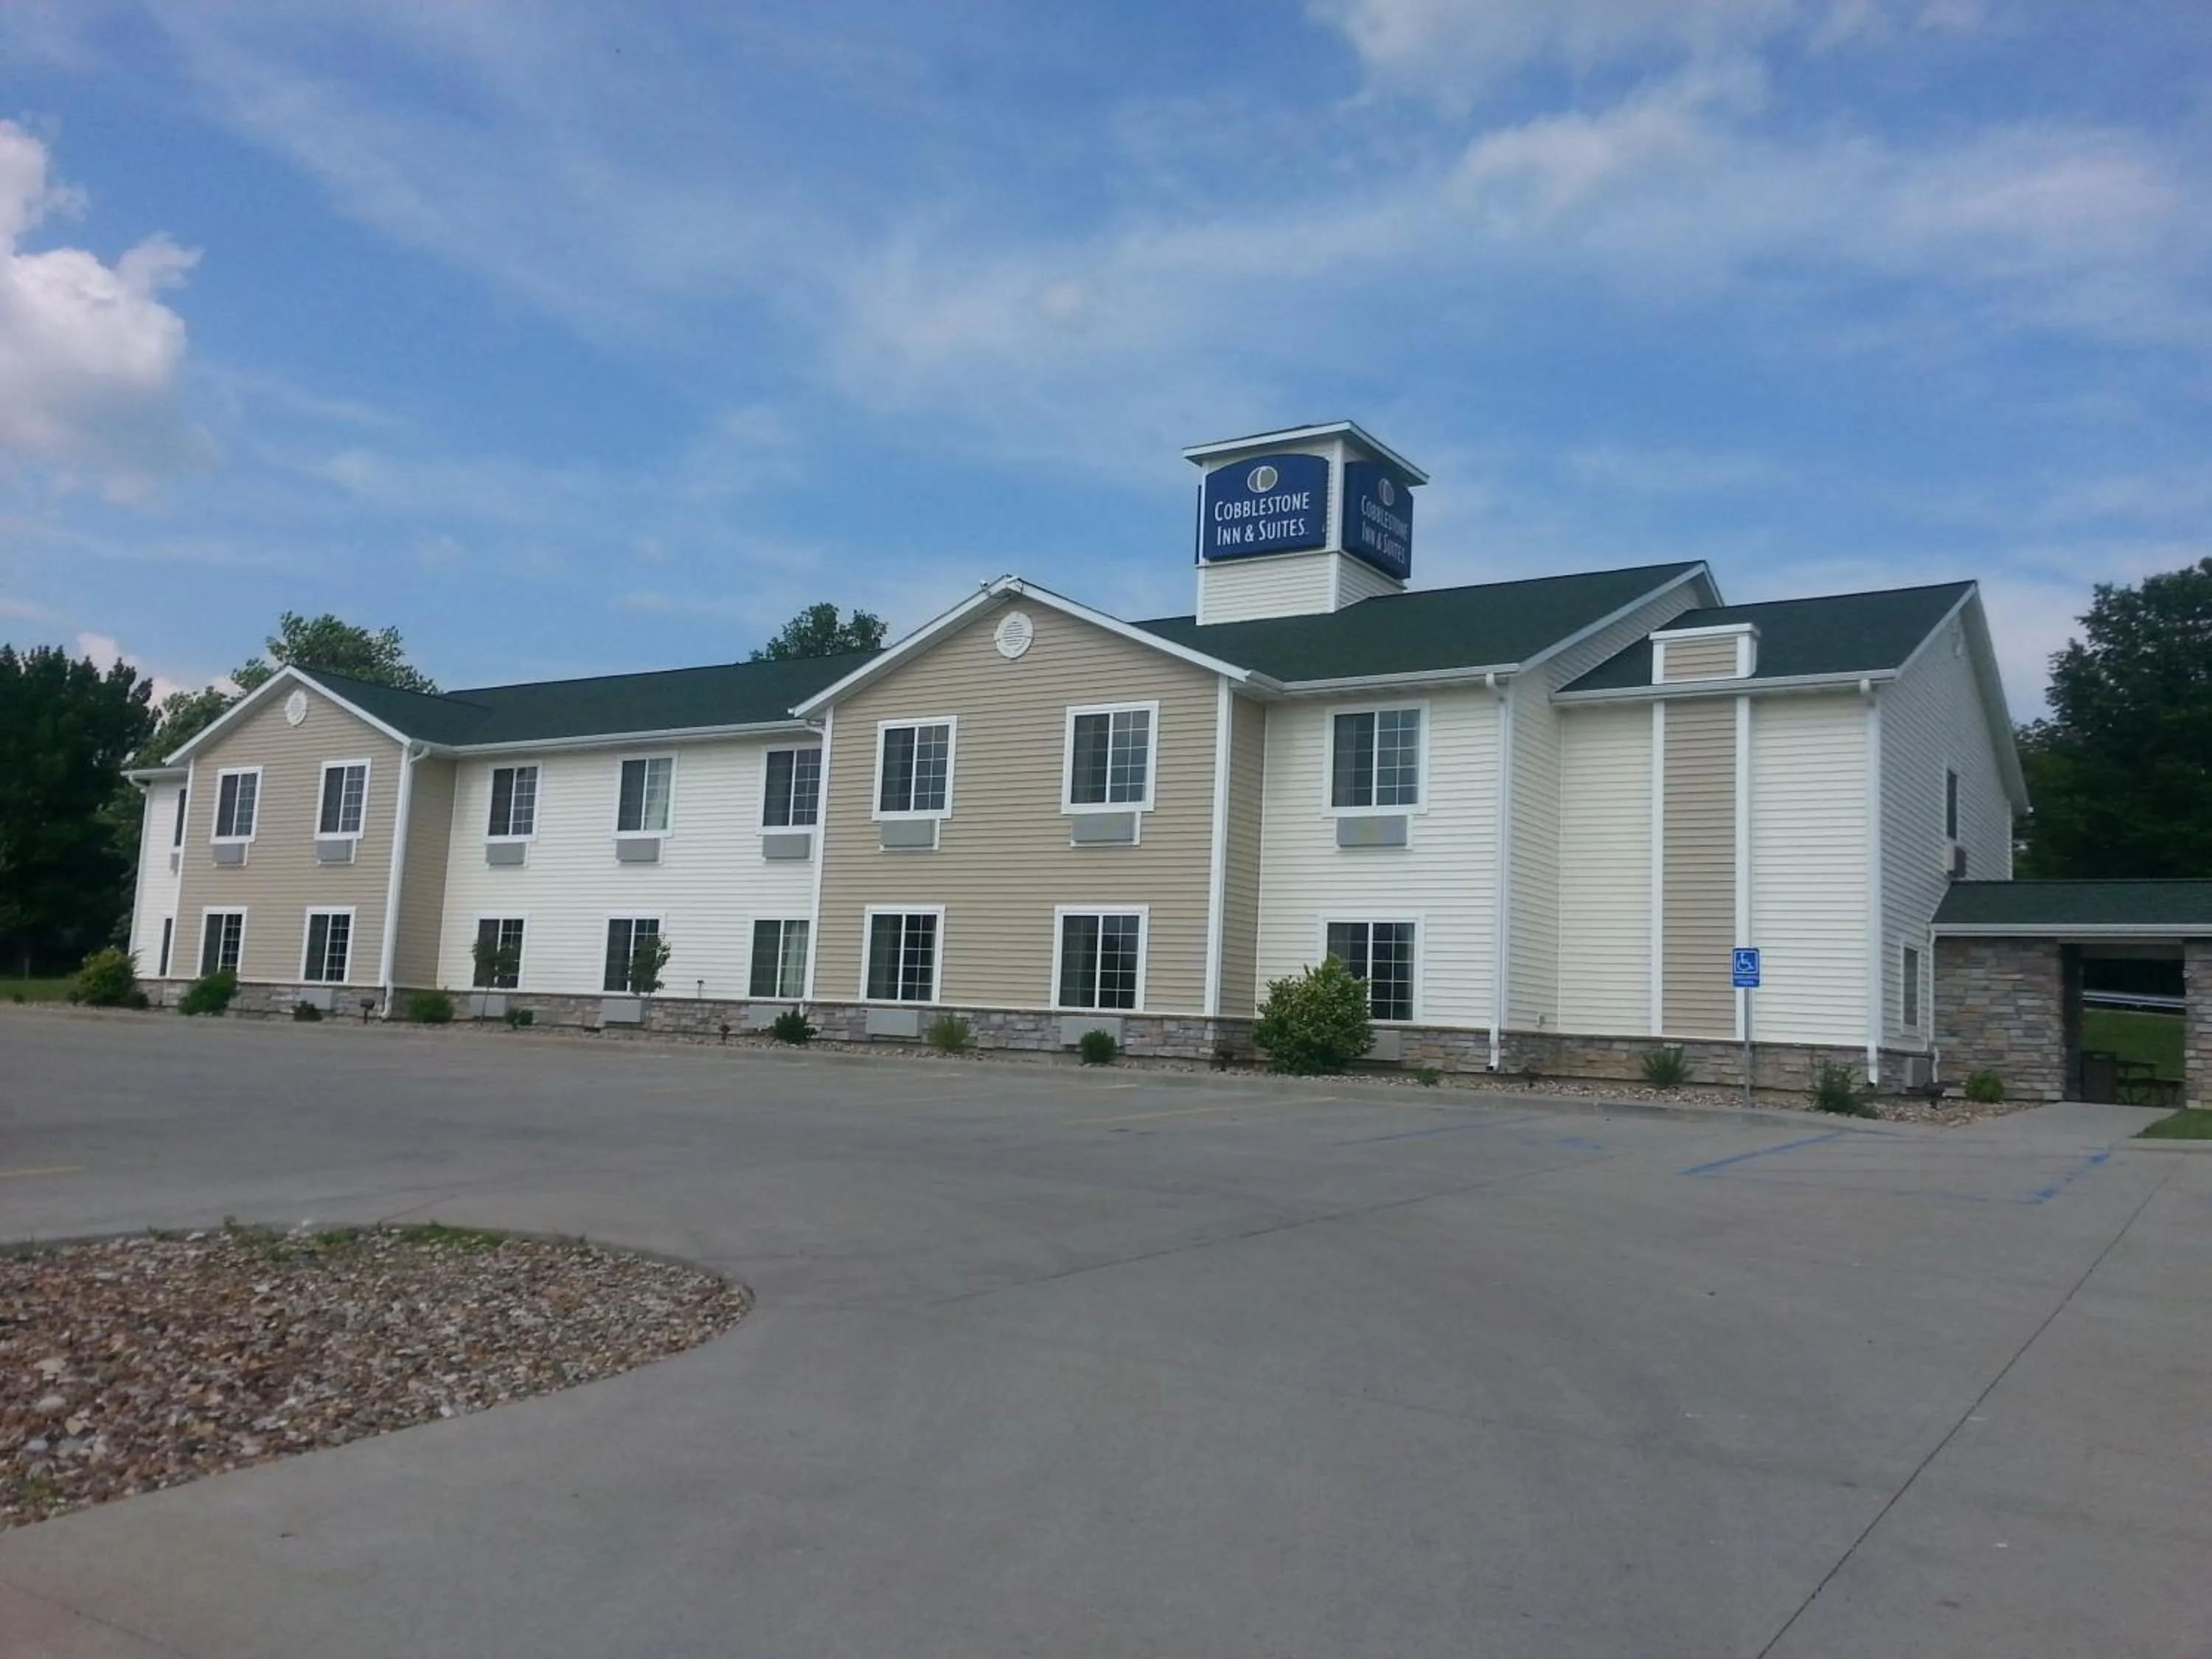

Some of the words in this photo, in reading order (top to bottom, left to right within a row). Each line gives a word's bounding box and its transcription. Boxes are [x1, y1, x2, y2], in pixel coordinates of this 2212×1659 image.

[1215, 493, 1310, 521] COBBLESTONE
[1217, 526, 1241, 546] INN
[1245, 524, 1253, 542] &
[1259, 518, 1304, 540] SUITES
